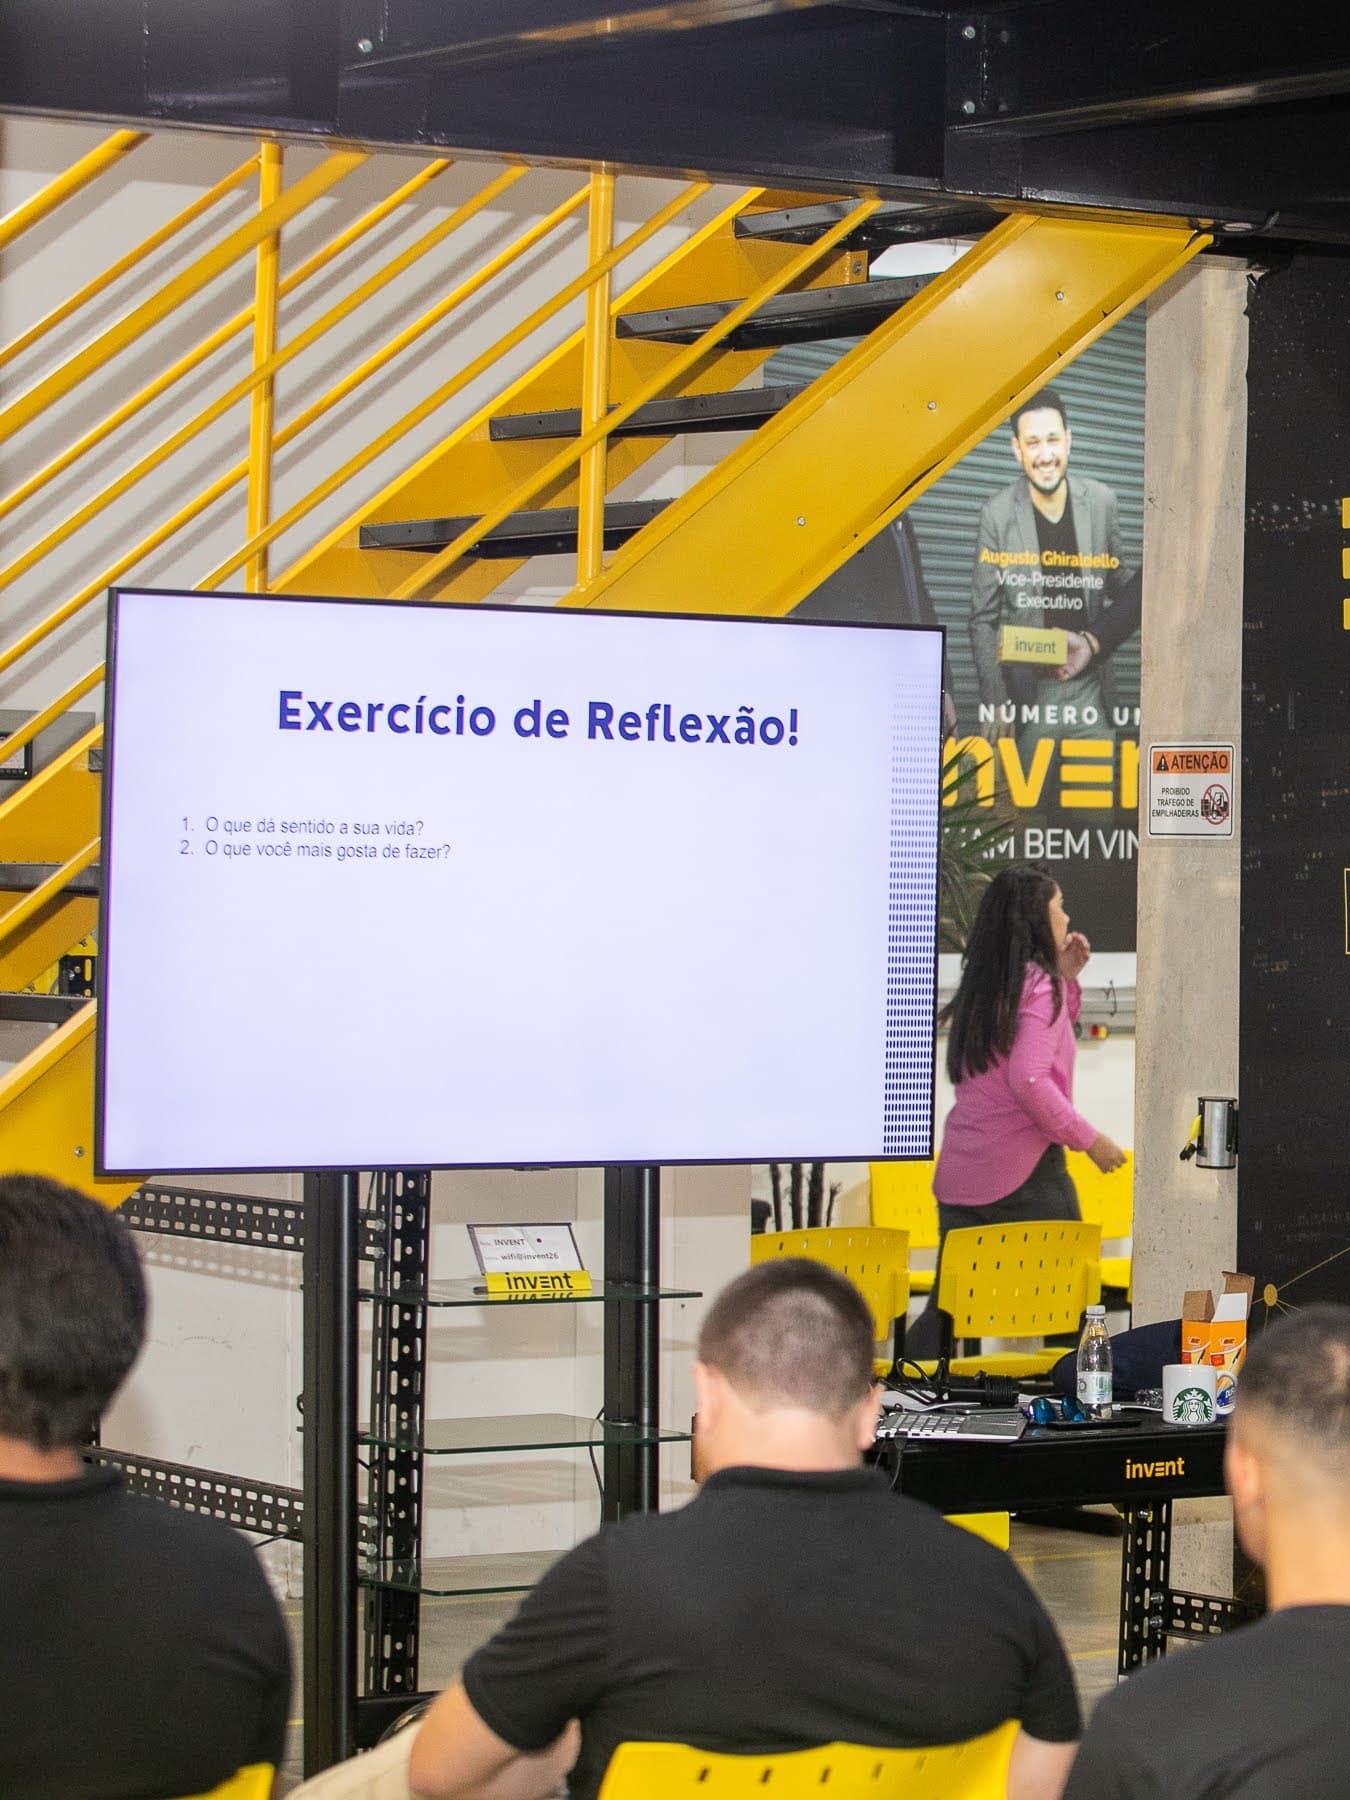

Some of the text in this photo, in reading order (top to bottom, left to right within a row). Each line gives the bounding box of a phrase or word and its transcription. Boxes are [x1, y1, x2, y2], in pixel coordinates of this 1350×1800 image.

[979, 548, 1119, 569] Augusto Ghiraldello
[996, 570, 1103, 590] Vice-Presidente
[1017, 592, 1083, 610] Executivo
[1015, 637, 1056, 654] invent
[278, 690, 799, 746] Exercício de Reflexão!
[978, 699, 1140, 726] NÚMERO U
[1171, 752, 1228, 773] ATENÇÃO
[1161, 787, 1190, 796] PROIBIDO
[1185, 799, 1195, 807] DE
[1152, 809, 1199, 818] EMPILHADEIRAS
[182, 816, 424, 837] 1. O que dá sentido a sua vida?
[180, 840, 451, 862] 2. O que você mais gosta de fazer?
[1024, 828, 1090, 860] BEM
[494, 1238, 525, 1246] INVENT
[505, 1271, 574, 1290] invent
[1125, 1456, 1185, 1479] invent
